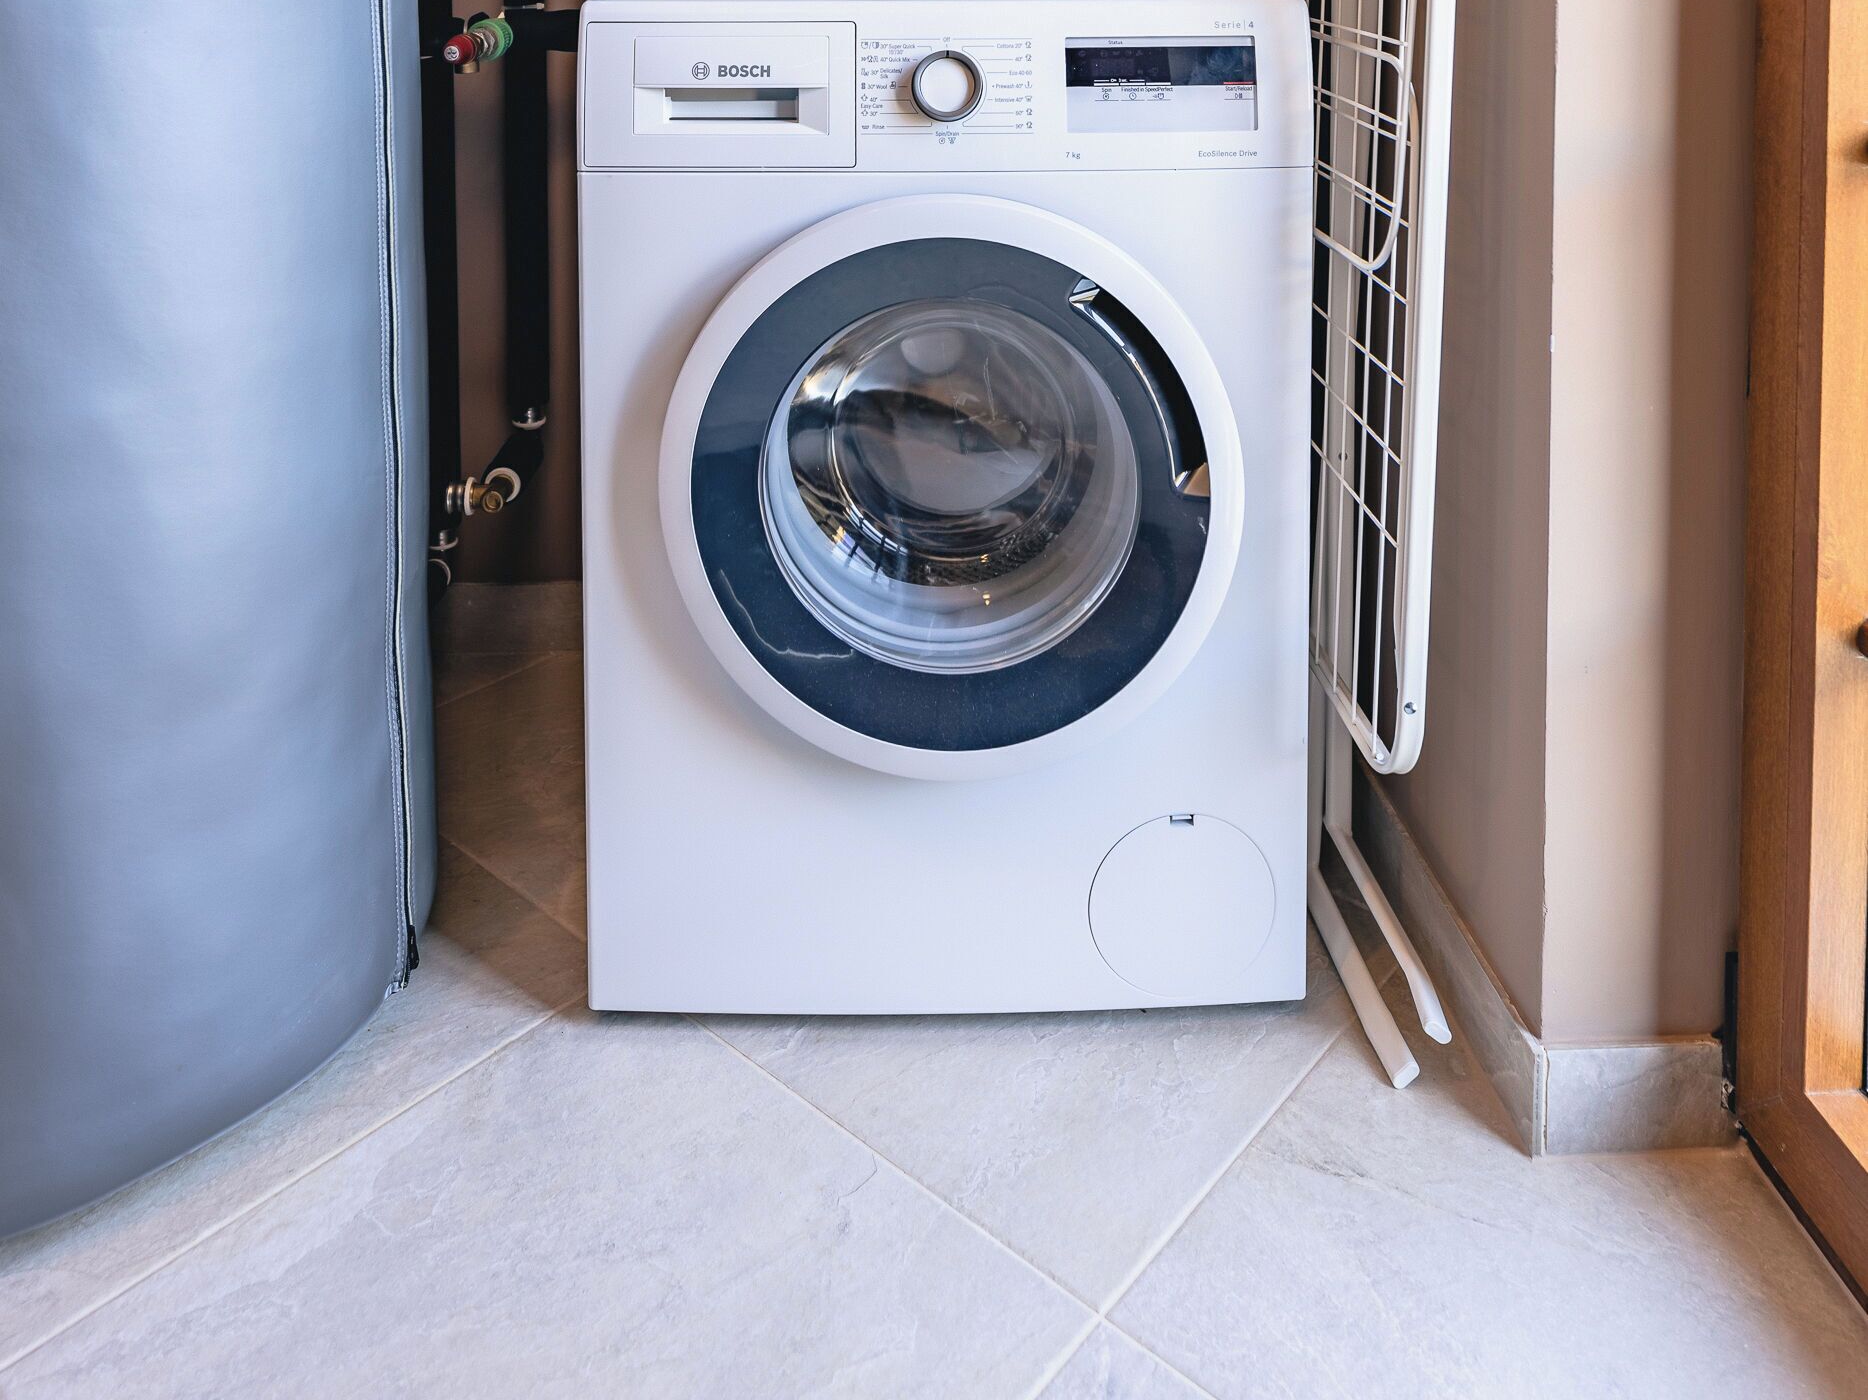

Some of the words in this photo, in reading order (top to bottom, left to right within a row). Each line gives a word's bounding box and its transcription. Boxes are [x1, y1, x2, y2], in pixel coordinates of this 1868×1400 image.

[718, 65, 770, 78] BOSCH
[1072, 152, 1080, 160] kg
[1198, 150, 1237, 158] EcoSilence
